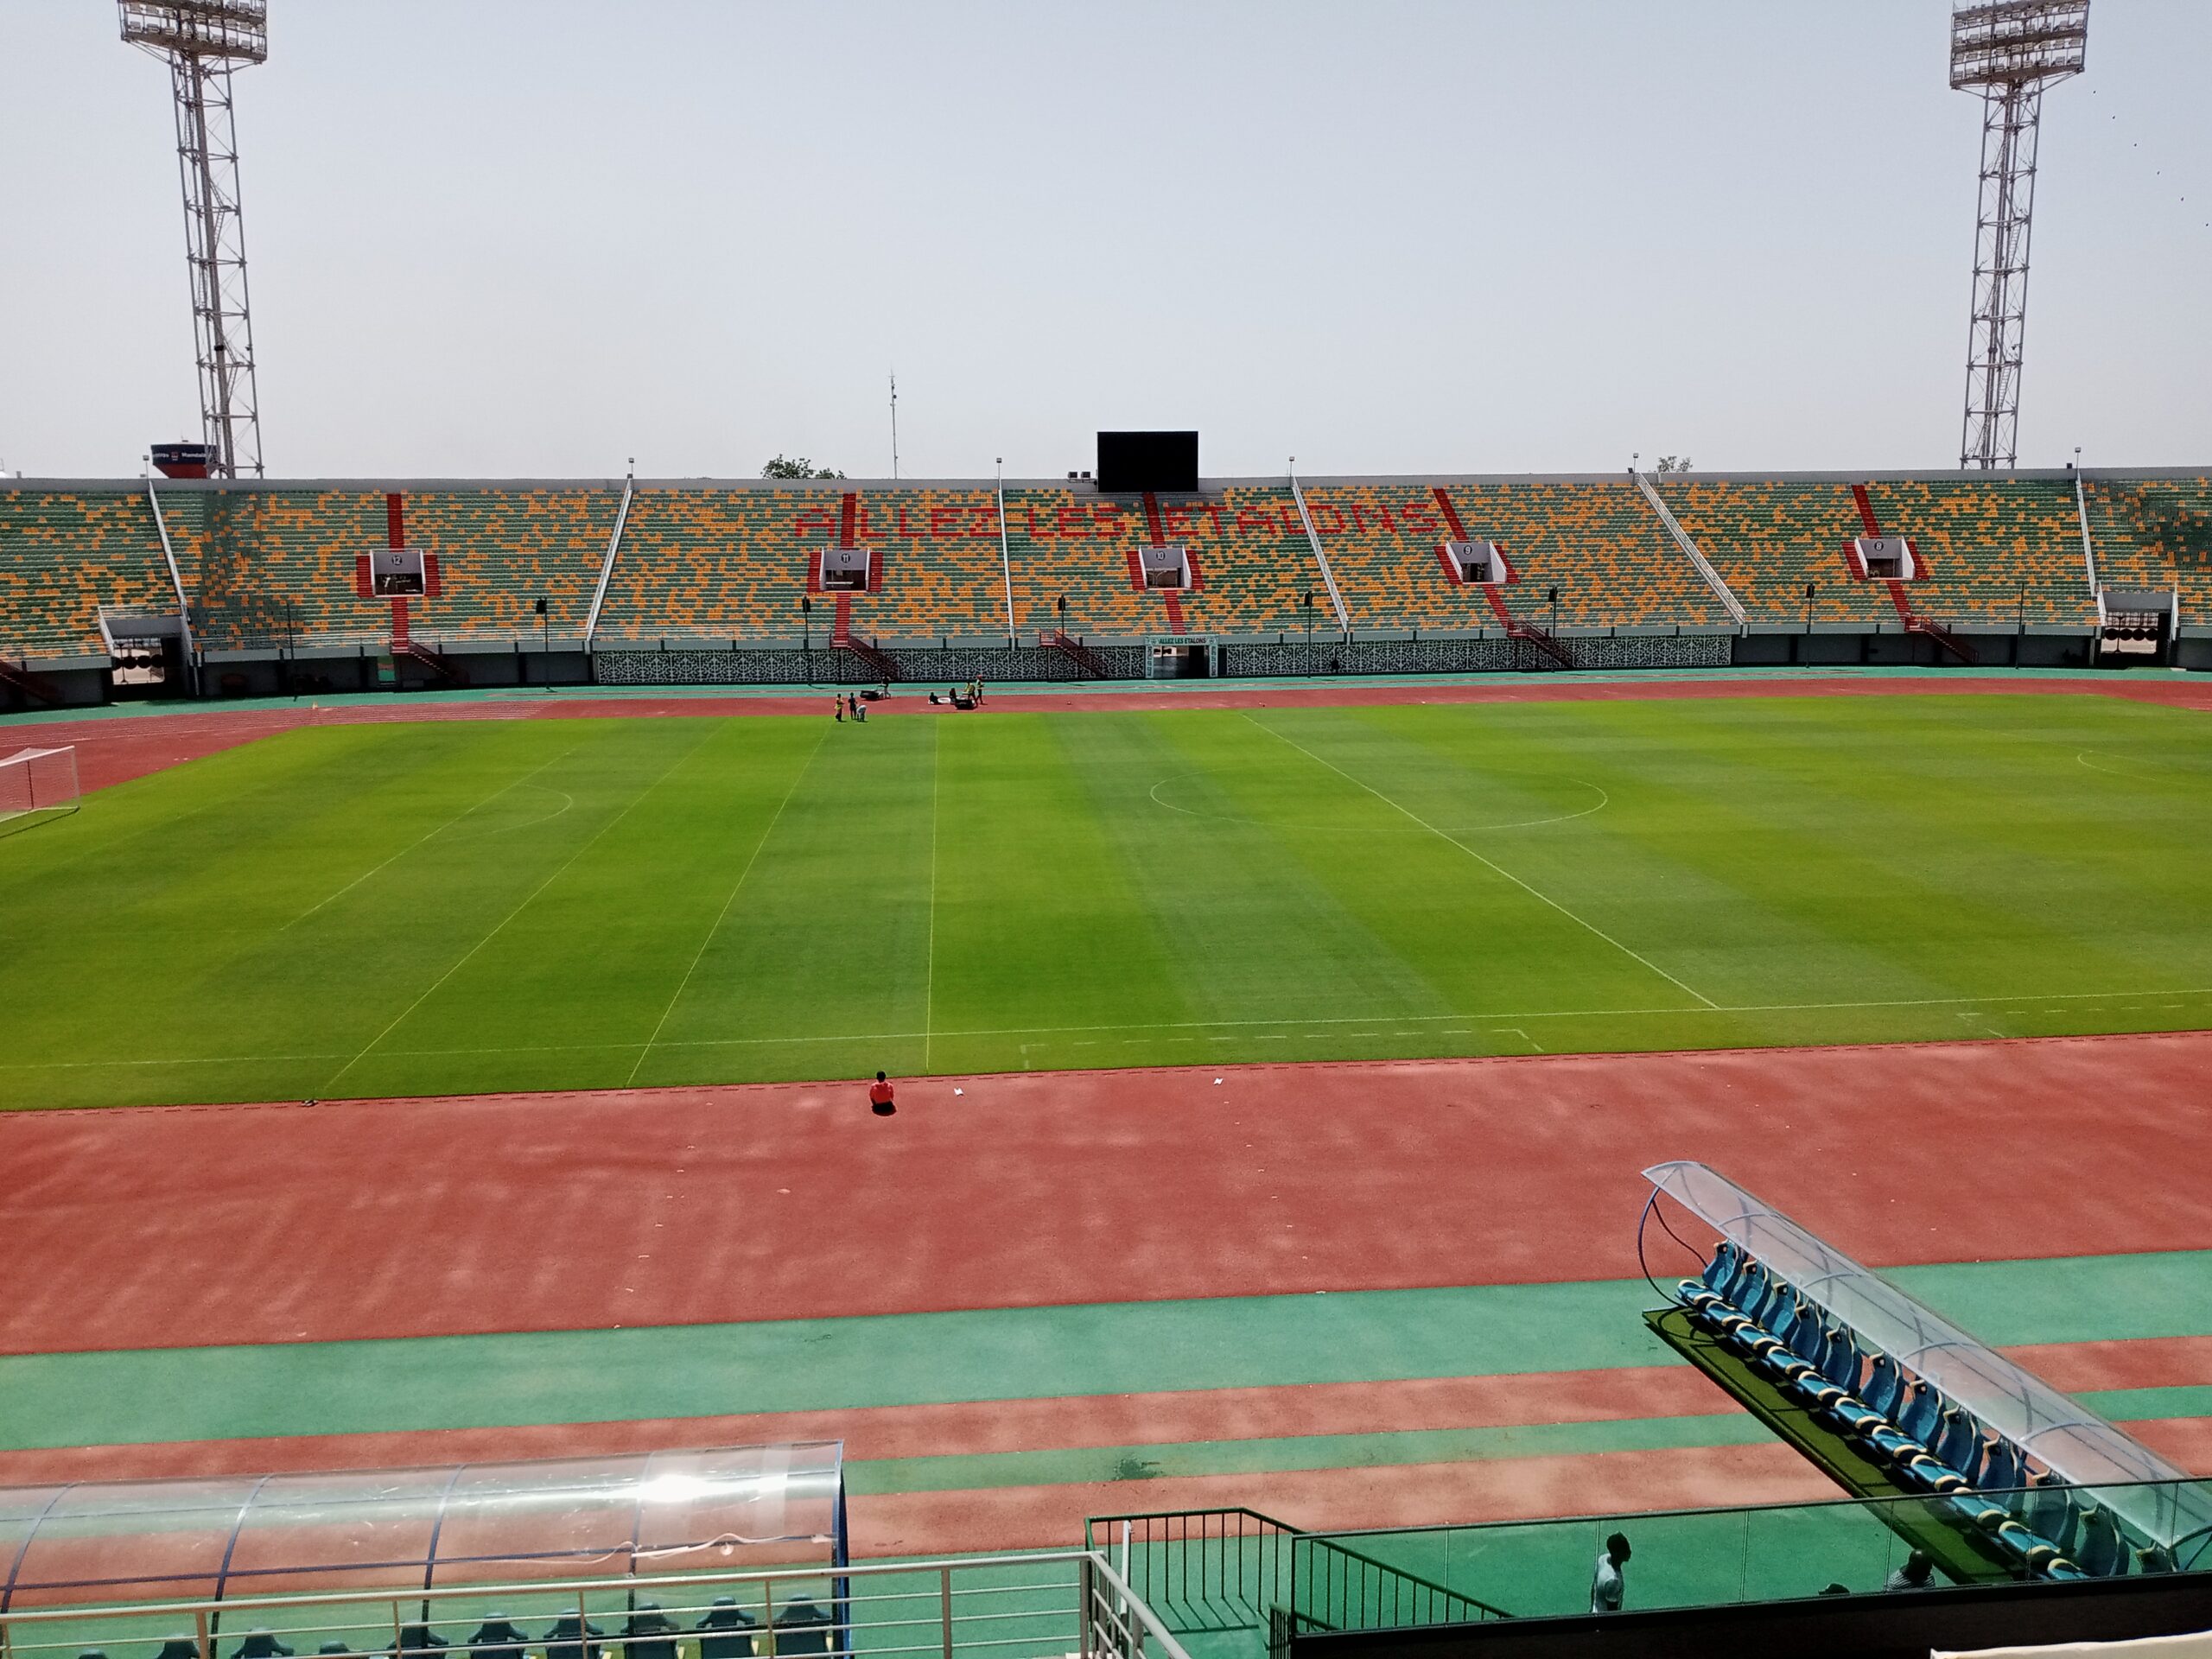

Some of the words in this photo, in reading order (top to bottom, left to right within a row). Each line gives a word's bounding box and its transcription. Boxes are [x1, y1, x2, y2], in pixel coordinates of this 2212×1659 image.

[794, 507, 1001, 537] ALLEZ
[1027, 506, 1127, 537] LES
[1164, 504, 1438, 536] ETALONS
[1465, 545, 1471, 555] 9
[1875, 542, 1883, 550] 8
[842, 554, 850, 563] 11
[1157, 551, 1165, 560] 10
[392, 556, 402, 565] 12
